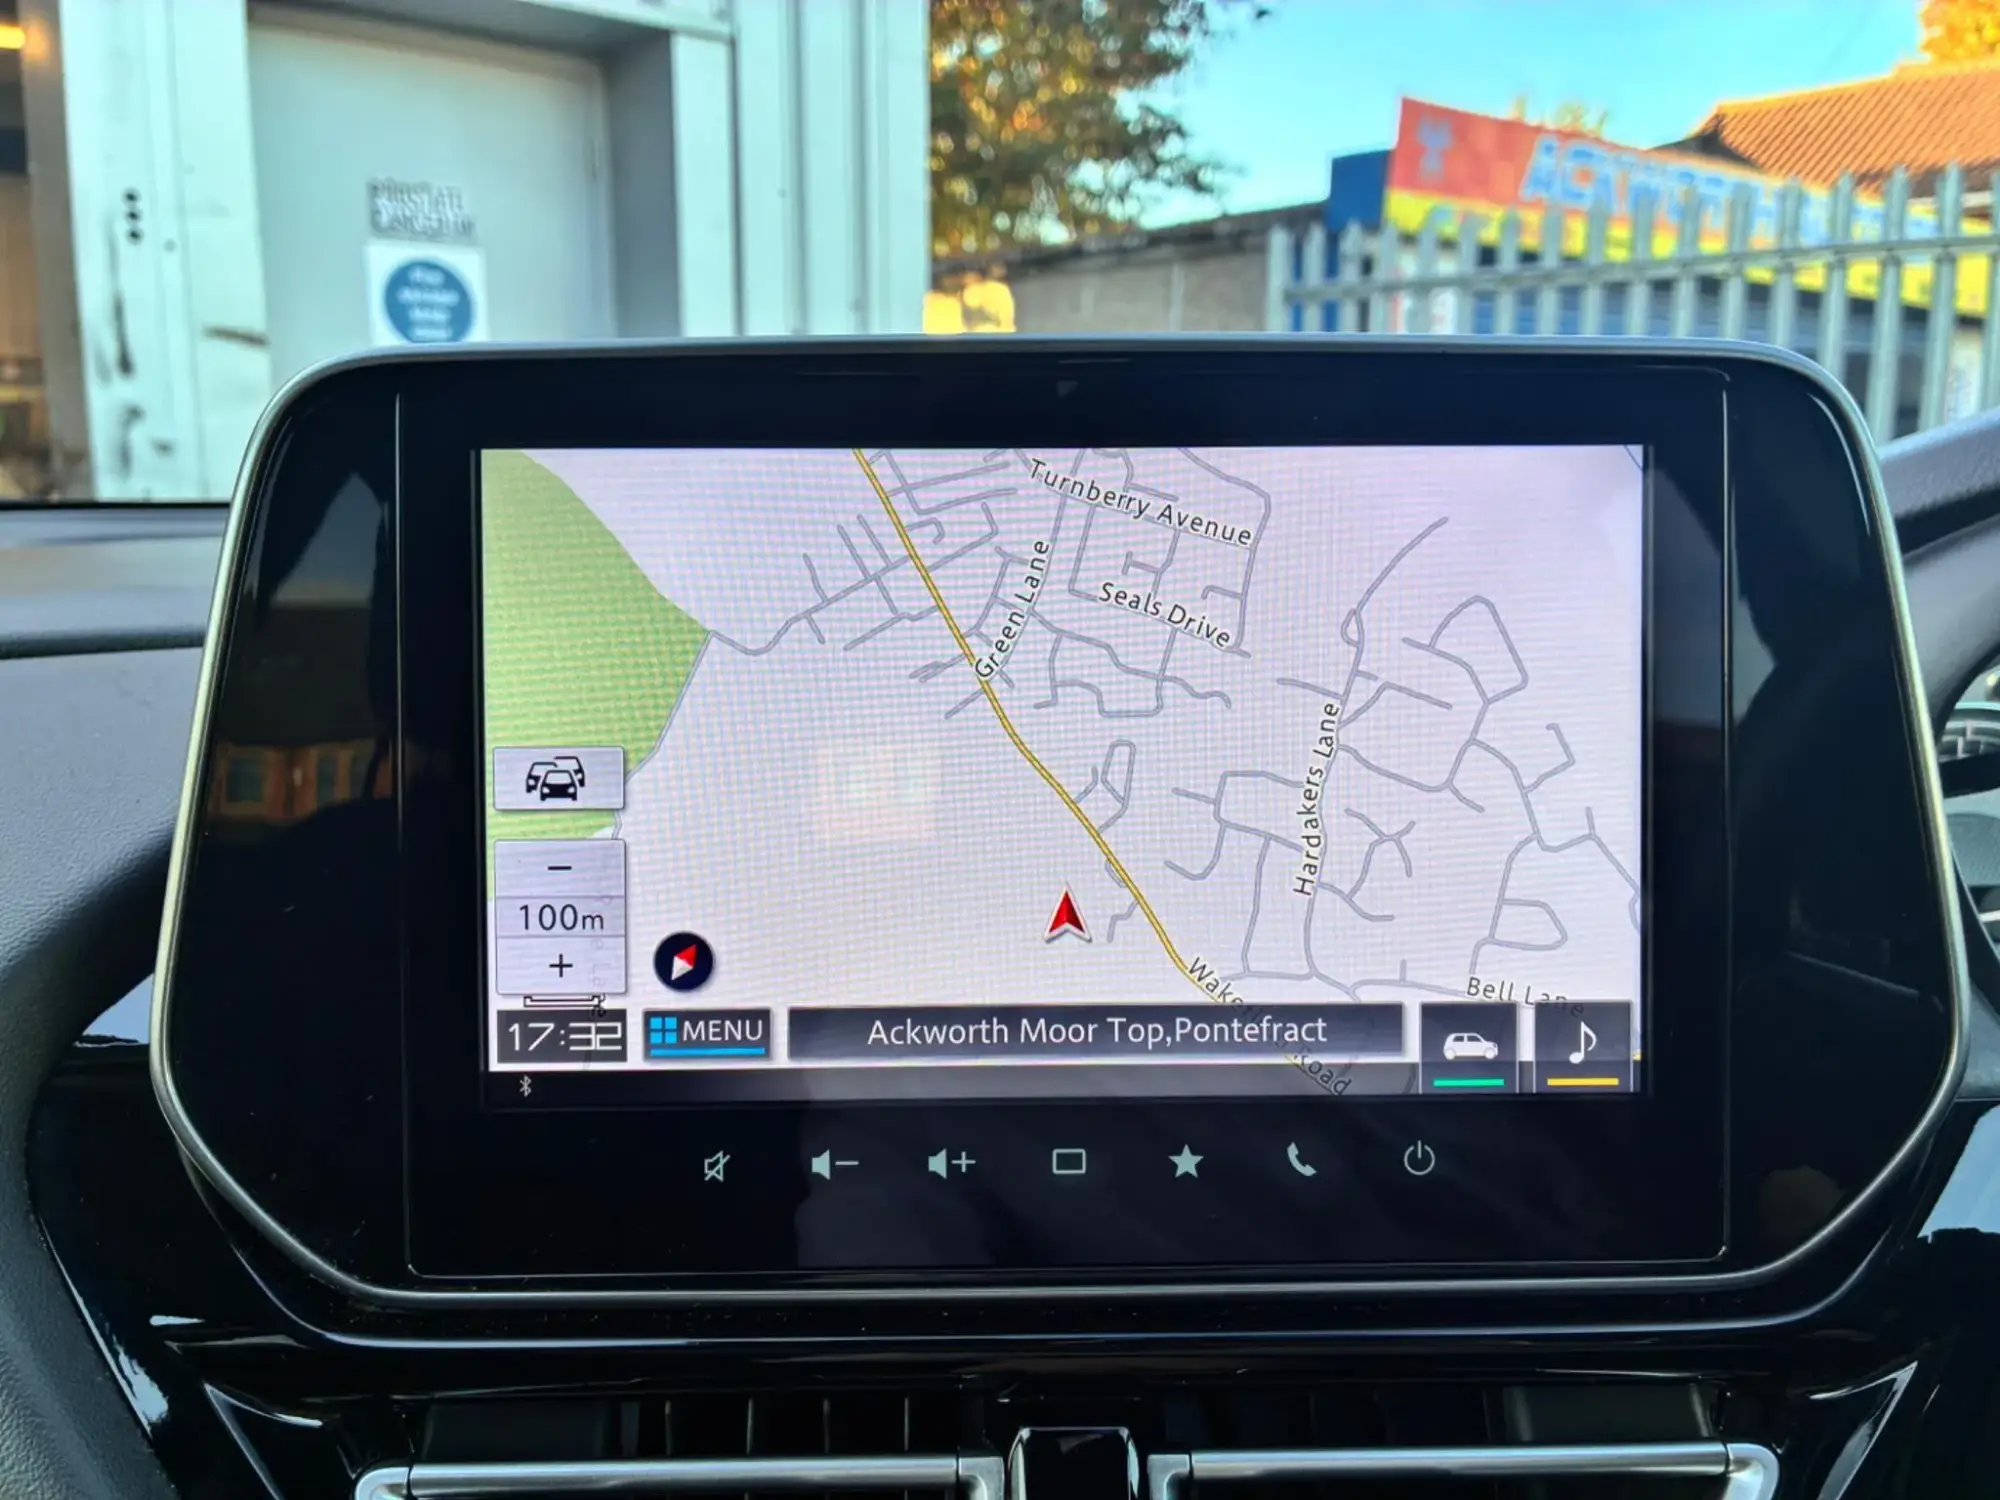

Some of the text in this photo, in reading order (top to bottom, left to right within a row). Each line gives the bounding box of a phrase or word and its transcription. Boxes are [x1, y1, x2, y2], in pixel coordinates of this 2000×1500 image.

[1030, 458, 1252, 546] Turnberry Avenue
[975, 540, 1049, 679] Green Lane
[1099, 582, 1231, 648] Seals Drive
[1293, 703, 1339, 896] Hardakers Lane
[519, 903, 604, 931] 100m
[1467, 976, 1513, 1001] Bell
[508, 1022, 623, 1051] 17:32
[682, 1019, 763, 1042] MENU
[867, 1015, 1328, 1051] Ackworth Moor Top,Pontefract
